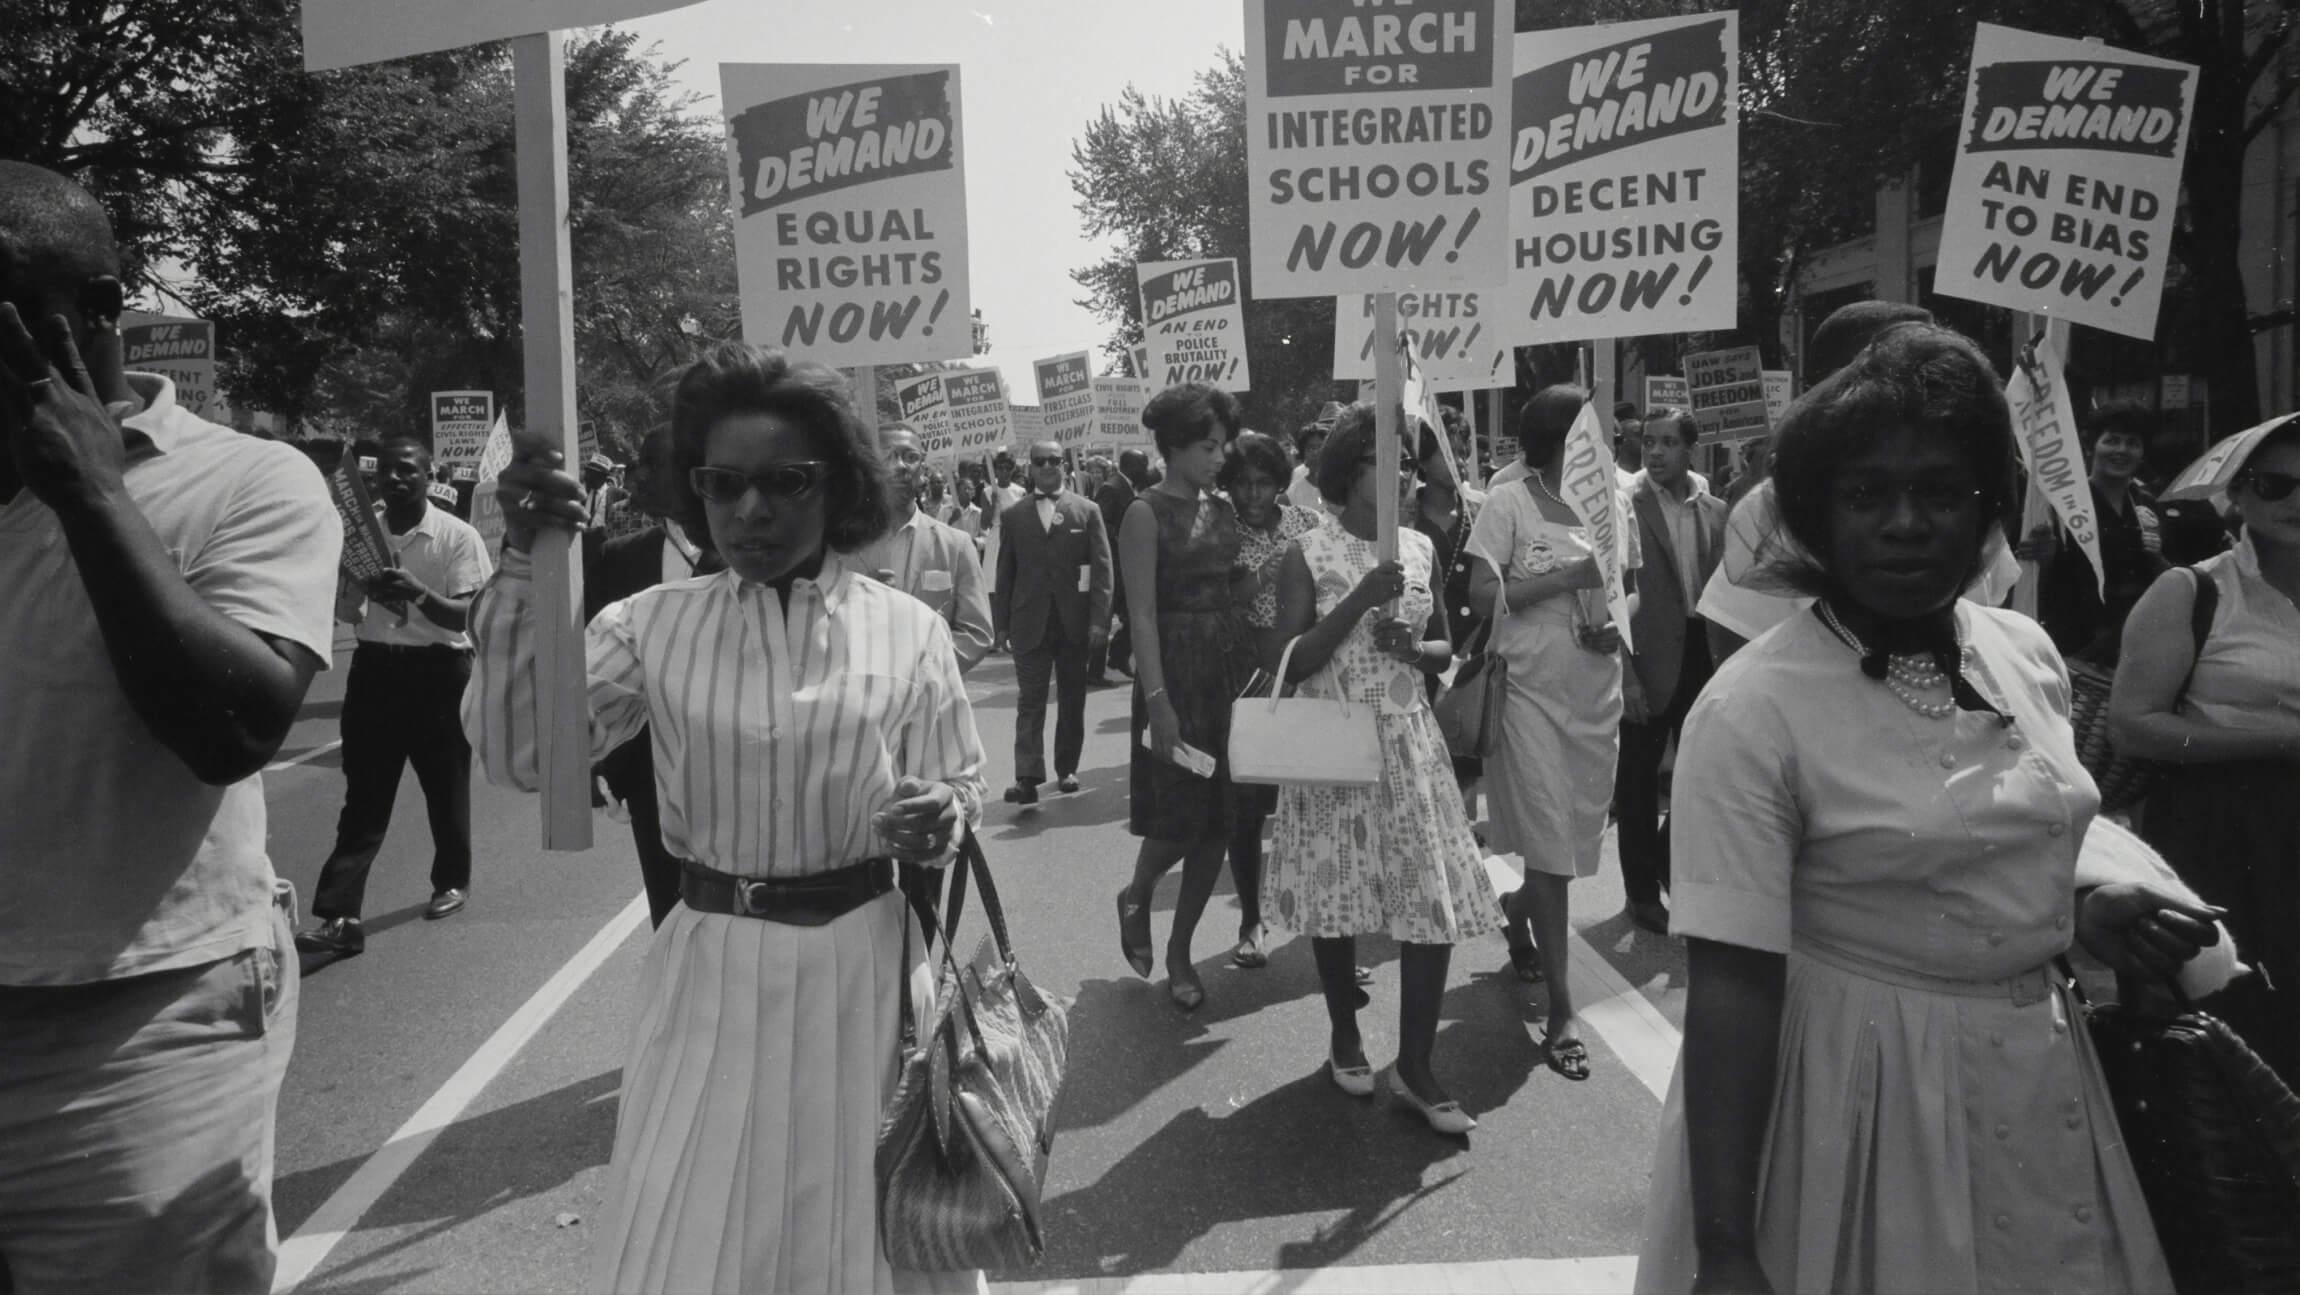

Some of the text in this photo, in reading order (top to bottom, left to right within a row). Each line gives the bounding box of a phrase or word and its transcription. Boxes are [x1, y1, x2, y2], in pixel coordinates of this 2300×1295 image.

[1283, 11, 1477, 60] MARCH
[1344, 63, 1419, 86] FOR
[1568, 42, 1652, 105] WE
[2043, 65, 2124, 102] WE
[806, 86, 882, 139] WE
[1267, 102, 1493, 150] INTEGRATED
[1511, 71, 1720, 173] DEMAND
[1981, 103, 2175, 144] DEMAND
[754, 118, 946, 200] DEMAND
[1269, 159, 1490, 205] SCHOOLS
[1532, 167, 1707, 218] DECENT
[1981, 160, 2160, 222] AN END
[776, 208, 935, 247] EQUAL
[1286, 206, 1481, 273] NOW!
[1515, 218, 1723, 269] HOUSING
[1981, 199, 2151, 262] TO BIAS
[776, 250, 943, 291] RIGHTS
[1172, 266, 1206, 292] WE
[1529, 254, 1713, 321] NOW!
[1973, 242, 2146, 308] NOW!
[782, 288, 950, 348] NOW!
[1151, 280, 1232, 320] DEMAND
[149, 325, 183, 341] WE
[1160, 318, 1229, 335] AN END
[1176, 337, 1219, 351] POLICE
[129, 338, 207, 360] DEMAND
[1164, 349, 1228, 365] BRUTALITY
[917, 377, 937, 396] WE
[962, 375, 979, 385] WE
[1044, 369, 1085, 390] MARCH
[1165, 357, 1239, 385] NOW!
[1692, 367, 1737, 388] JOBS
[453, 397, 471, 405] WE
[951, 382, 996, 399] MARCH
[1693, 383, 1763, 409] FREEDOM
[440, 405, 486, 416] MARCH
[953, 415, 1007, 432] SCHOOLS
[961, 425, 1007, 448] NOW!
[1053, 418, 1094, 443] NOW!
